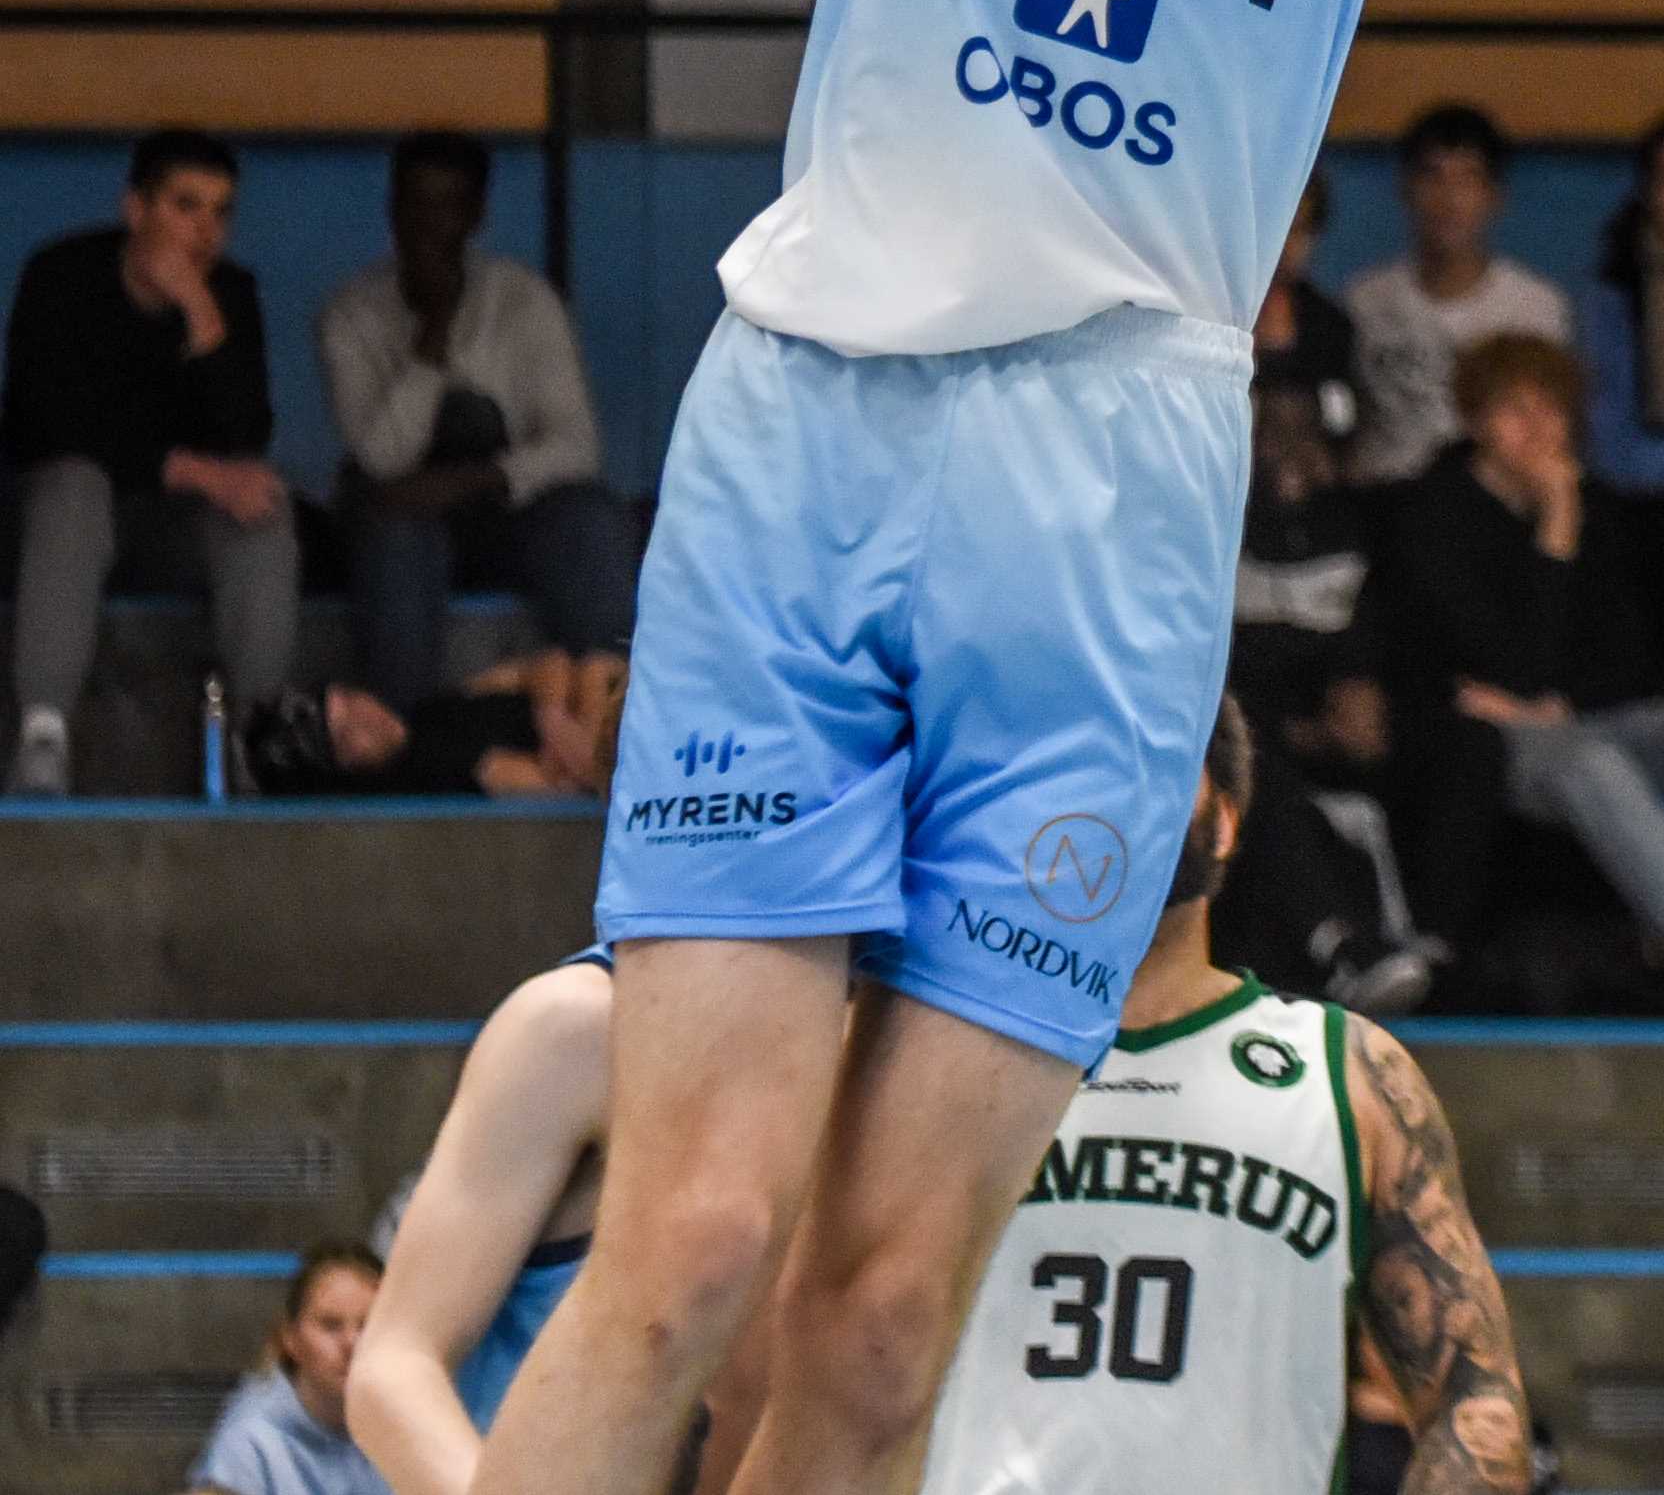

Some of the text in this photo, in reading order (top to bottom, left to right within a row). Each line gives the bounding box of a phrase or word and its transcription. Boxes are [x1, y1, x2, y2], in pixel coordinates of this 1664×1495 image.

[956, 35, 1177, 167] OBOS
[625, 791, 797, 832] MYRENS
[946, 897, 1119, 1005] NORDVIK
[1019, 1136, 1337, 1260] MERUD
[1025, 1254, 1193, 1384] 30
